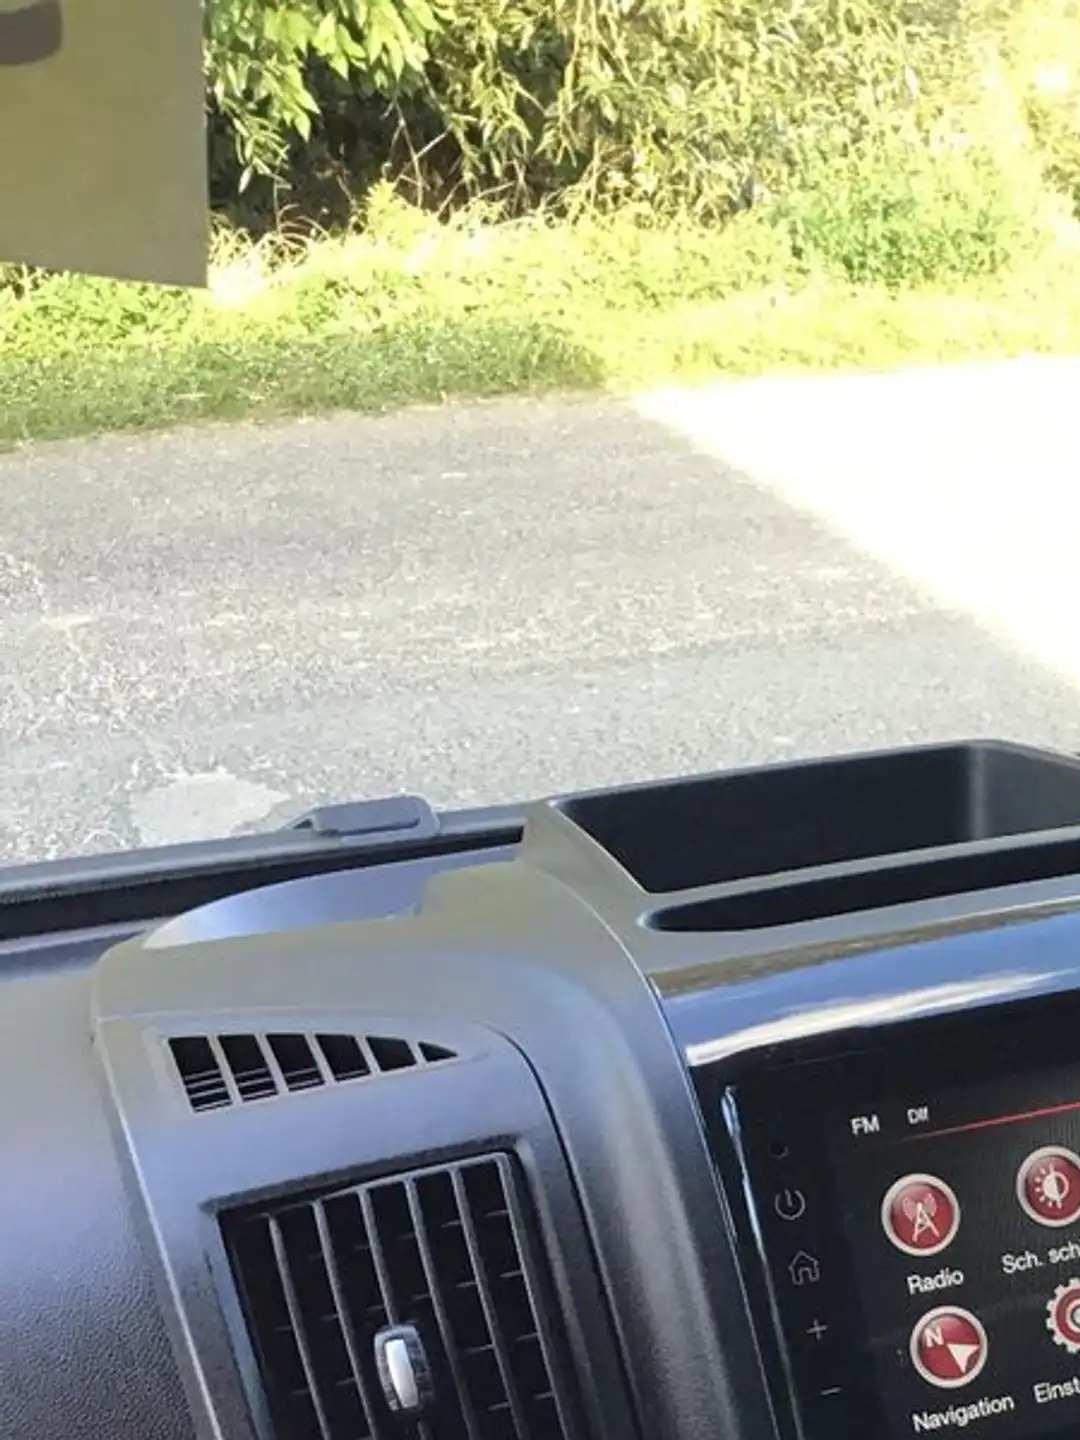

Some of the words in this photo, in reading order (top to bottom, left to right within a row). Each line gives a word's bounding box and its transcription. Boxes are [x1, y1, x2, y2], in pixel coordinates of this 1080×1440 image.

[851, 1114, 880, 1136] FM
[1001, 1252, 1042, 1275] Sch.
[907, 1267, 965, 1295] Radio
[923, 1327, 944, 1348] N
[912, 1395, 1015, 1432] Navigation
